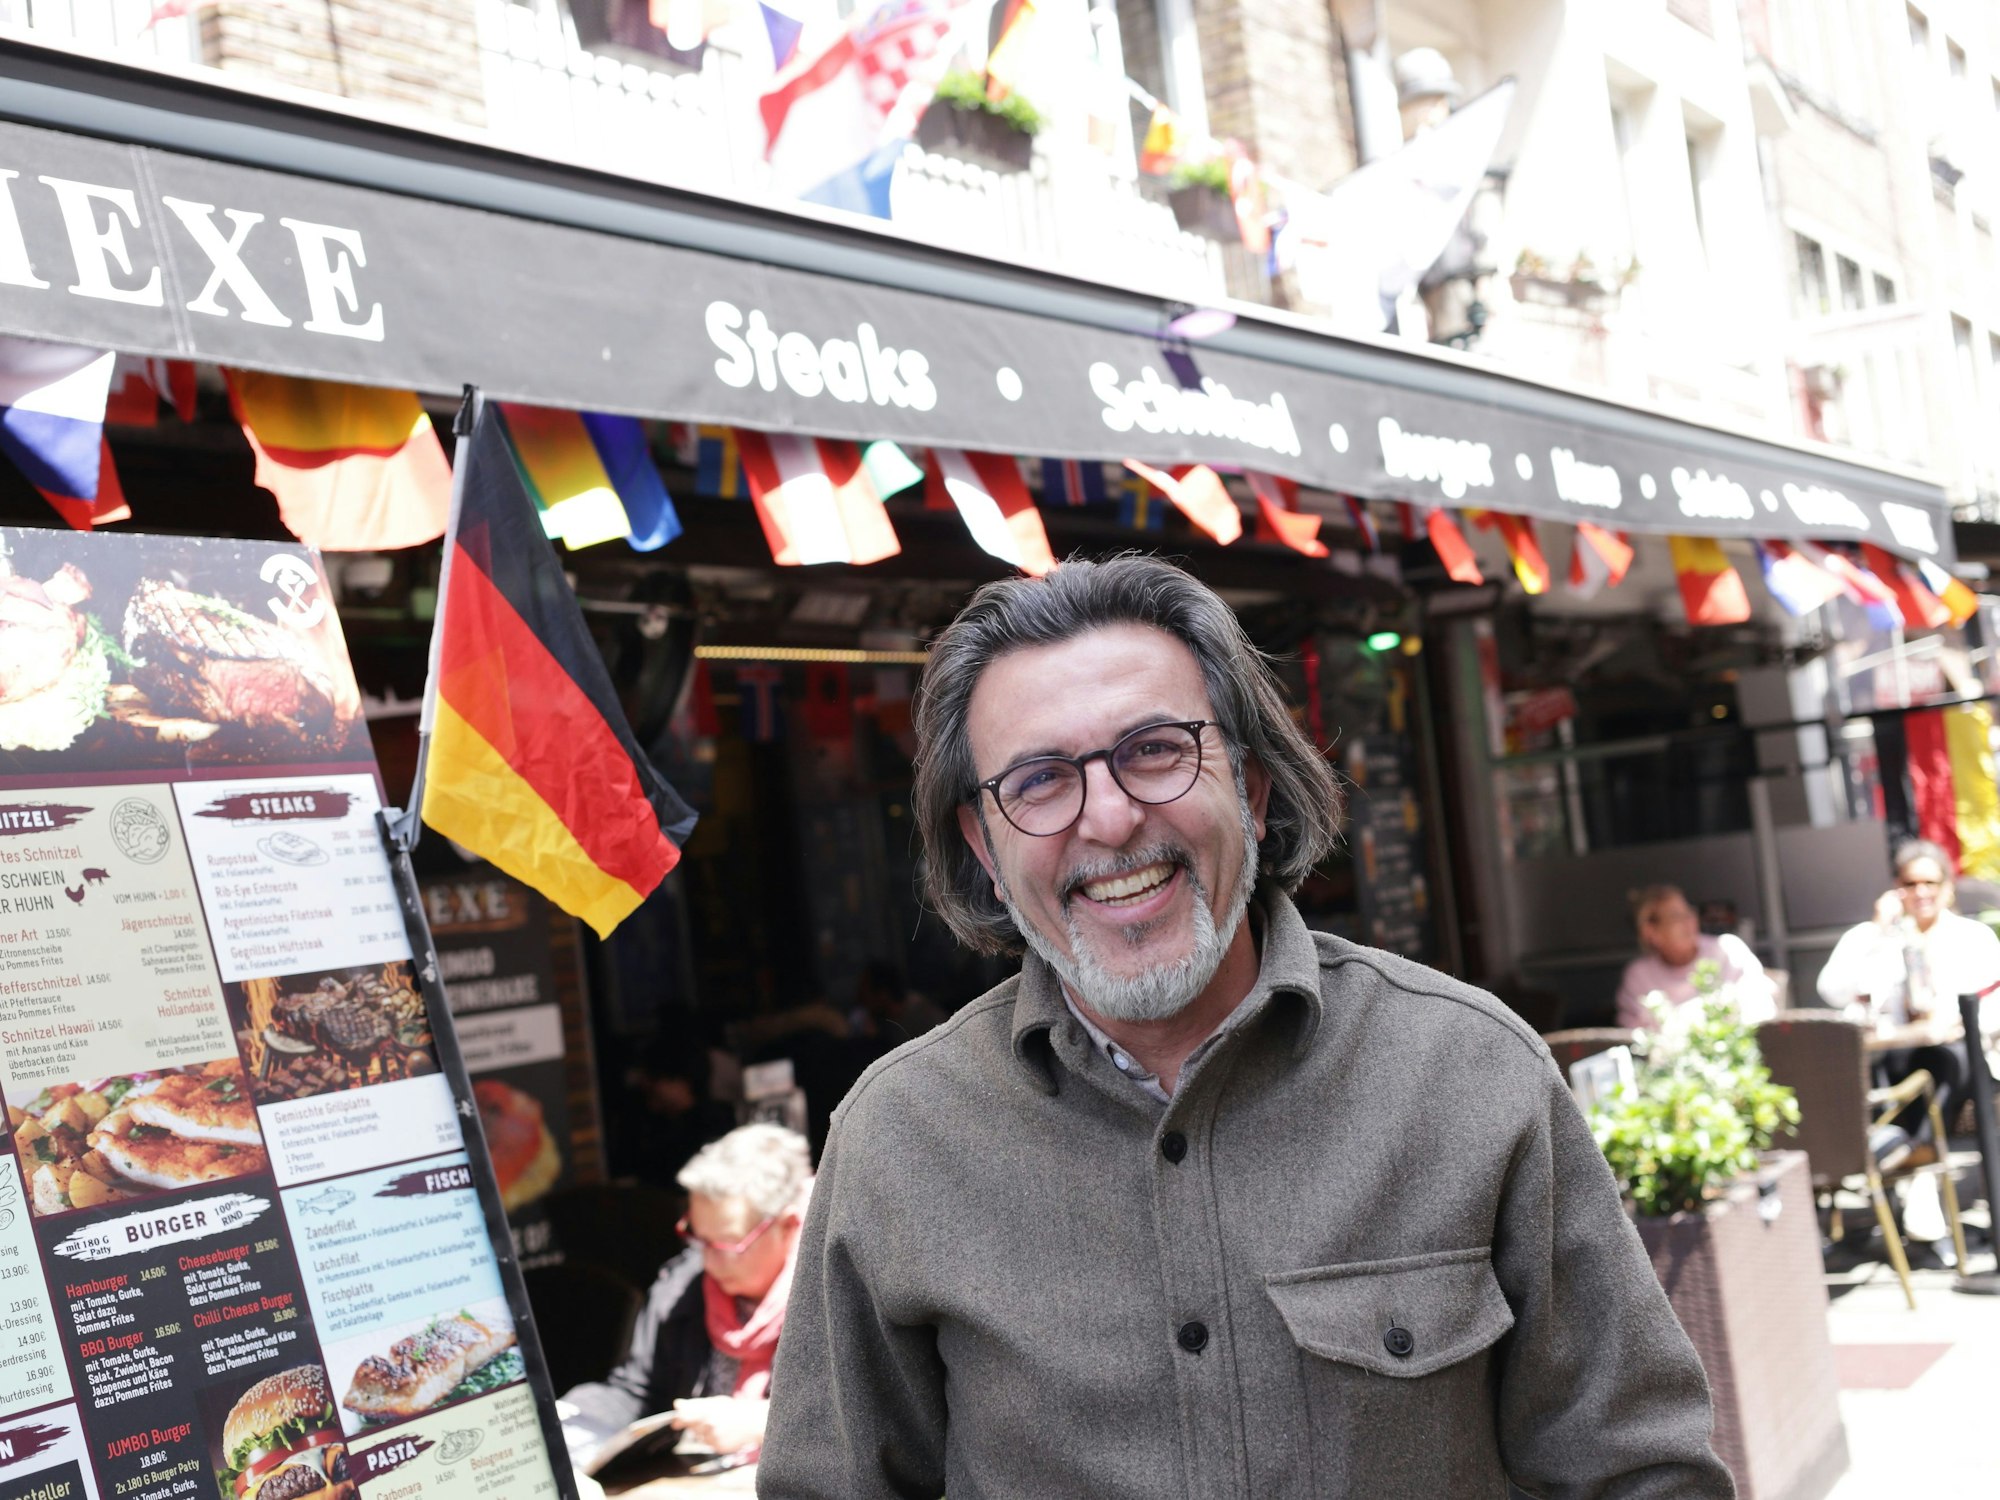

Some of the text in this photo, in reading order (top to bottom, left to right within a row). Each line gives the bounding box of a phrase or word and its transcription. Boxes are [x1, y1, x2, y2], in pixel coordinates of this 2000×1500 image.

[705, 301, 937, 411] Steaks
[250, 796, 316, 815] STEAKS
[0, 810, 54, 829] ITZEL
[23, 845, 82, 862] Schnitzel
[207, 852, 258, 867] Rumpsteak
[1, 870, 65, 889] SCHWEIN
[15, 896, 54, 912] HUHN
[113, 891, 156, 904] VOM HUHN
[427, 881, 510, 925] EXE
[121, 912, 194, 933] Jägerschnitzel
[0, 928, 72, 944] ner Art 13.50€
[0, 945, 62, 959] Zitronenscheibe
[6, 956, 64, 970] Pommes Frites
[86, 973, 112, 985] 14.50€
[9, 993, 61, 1007] Pfeffersauce
[164, 985, 212, 1002] Schnitzel
[18, 1004, 76, 1019] Pommes Frites
[157, 1001, 215, 1017] Hollandaise
[1, 1019, 124, 1044] Schnitzel Hawaii 14.50€
[197, 1016, 219, 1028] 14.50€
[6, 1038, 89, 1058] mit Ananas und Käse
[158, 1033, 201, 1047] Hollandaise
[8, 1053, 76, 1070] überbacken dazu
[11, 1064, 70, 1081] Pommes Frites
[274, 1105, 324, 1124] Gemischte
[424, 1168, 471, 1191] FISCH
[214, 1199, 241, 1216] 100%
[125, 1211, 208, 1243] BURGER
[221, 1210, 244, 1226] RIND
[305, 1217, 357, 1239] Zanderfilet
[0, 1245, 19, 1257] sing
[66, 1235, 110, 1253] mit 180 G
[90, 1246, 112, 1257] Patty
[178, 1238, 279, 1270] Cheeseburger 15.50€
[313, 1252, 360, 1273] Lachsfilet
[0, 1263, 30, 1279] 13.90€
[183, 1261, 251, 1284] mit Tomate, Gurke,
[65, 1265, 168, 1298] Hamburger 14.50€
[186, 1274, 242, 1296] Salat und Käse
[70, 1287, 144, 1313] mit Tomate, Gurke,
[189, 1281, 261, 1307] dazu Pommes Frites
[321, 1282, 375, 1304] Fischplatte
[10, 1297, 39, 1313] 13.90€
[193, 1292, 294, 1328] Chilli Cheese Burger
[73, 1306, 117, 1324] Salat dazu
[76, 1313, 135, 1336] Pommes Frites
[273, 1307, 297, 1323] 15.90€
[17, 1331, 47, 1347] 14.90€
[80, 1322, 181, 1358] BBQ Burger 16.50€
[201, 1327, 268, 1353] mit Tomate, Gurke,
[203, 1330, 297, 1364] Salat, Jalapenos und Käse
[85, 1345, 159, 1373] mit Tomate, Gurke,
[207, 1347, 279, 1376] dazu Pommes Frites
[26, 1365, 55, 1381] 16.90€
[88, 1354, 174, 1385] Salat, Zwiebel, Bacon
[92, 1367, 169, 1397] Jalapenos und Käse
[94, 1378, 173, 1409] dazu Pommes Frites
[107, 1422, 191, 1460] JUMBO Burger
[140, 1450, 168, 1469] 18.90€
[366, 1440, 418, 1471] PASTA
[115, 1459, 200, 1495] 2x 180 G Burger Patty
[173, 1479, 197, 1494] Gurke,
